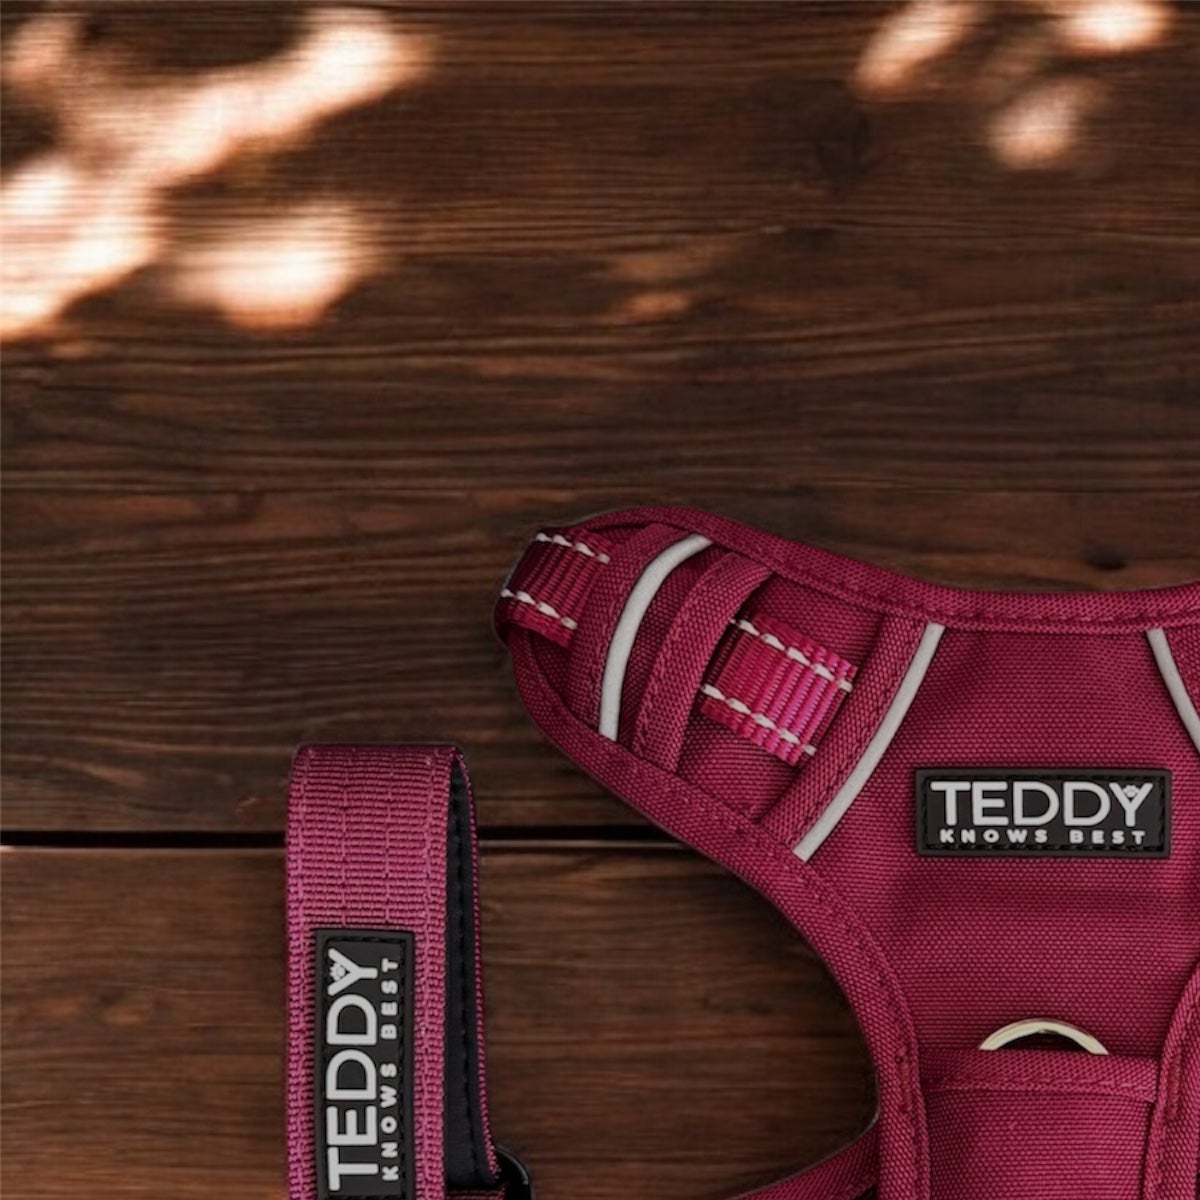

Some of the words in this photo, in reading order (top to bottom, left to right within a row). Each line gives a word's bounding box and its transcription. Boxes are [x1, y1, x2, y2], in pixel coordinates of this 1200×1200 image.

[930, 781, 1153, 827] TEDDY
[939, 829, 1048, 844] KNOWS
[1069, 830, 1146, 844] BEST
[380, 958, 399, 1039] BEST
[326, 948, 379, 1191] TEDDY
[380, 1063, 399, 1181] KNOWS
